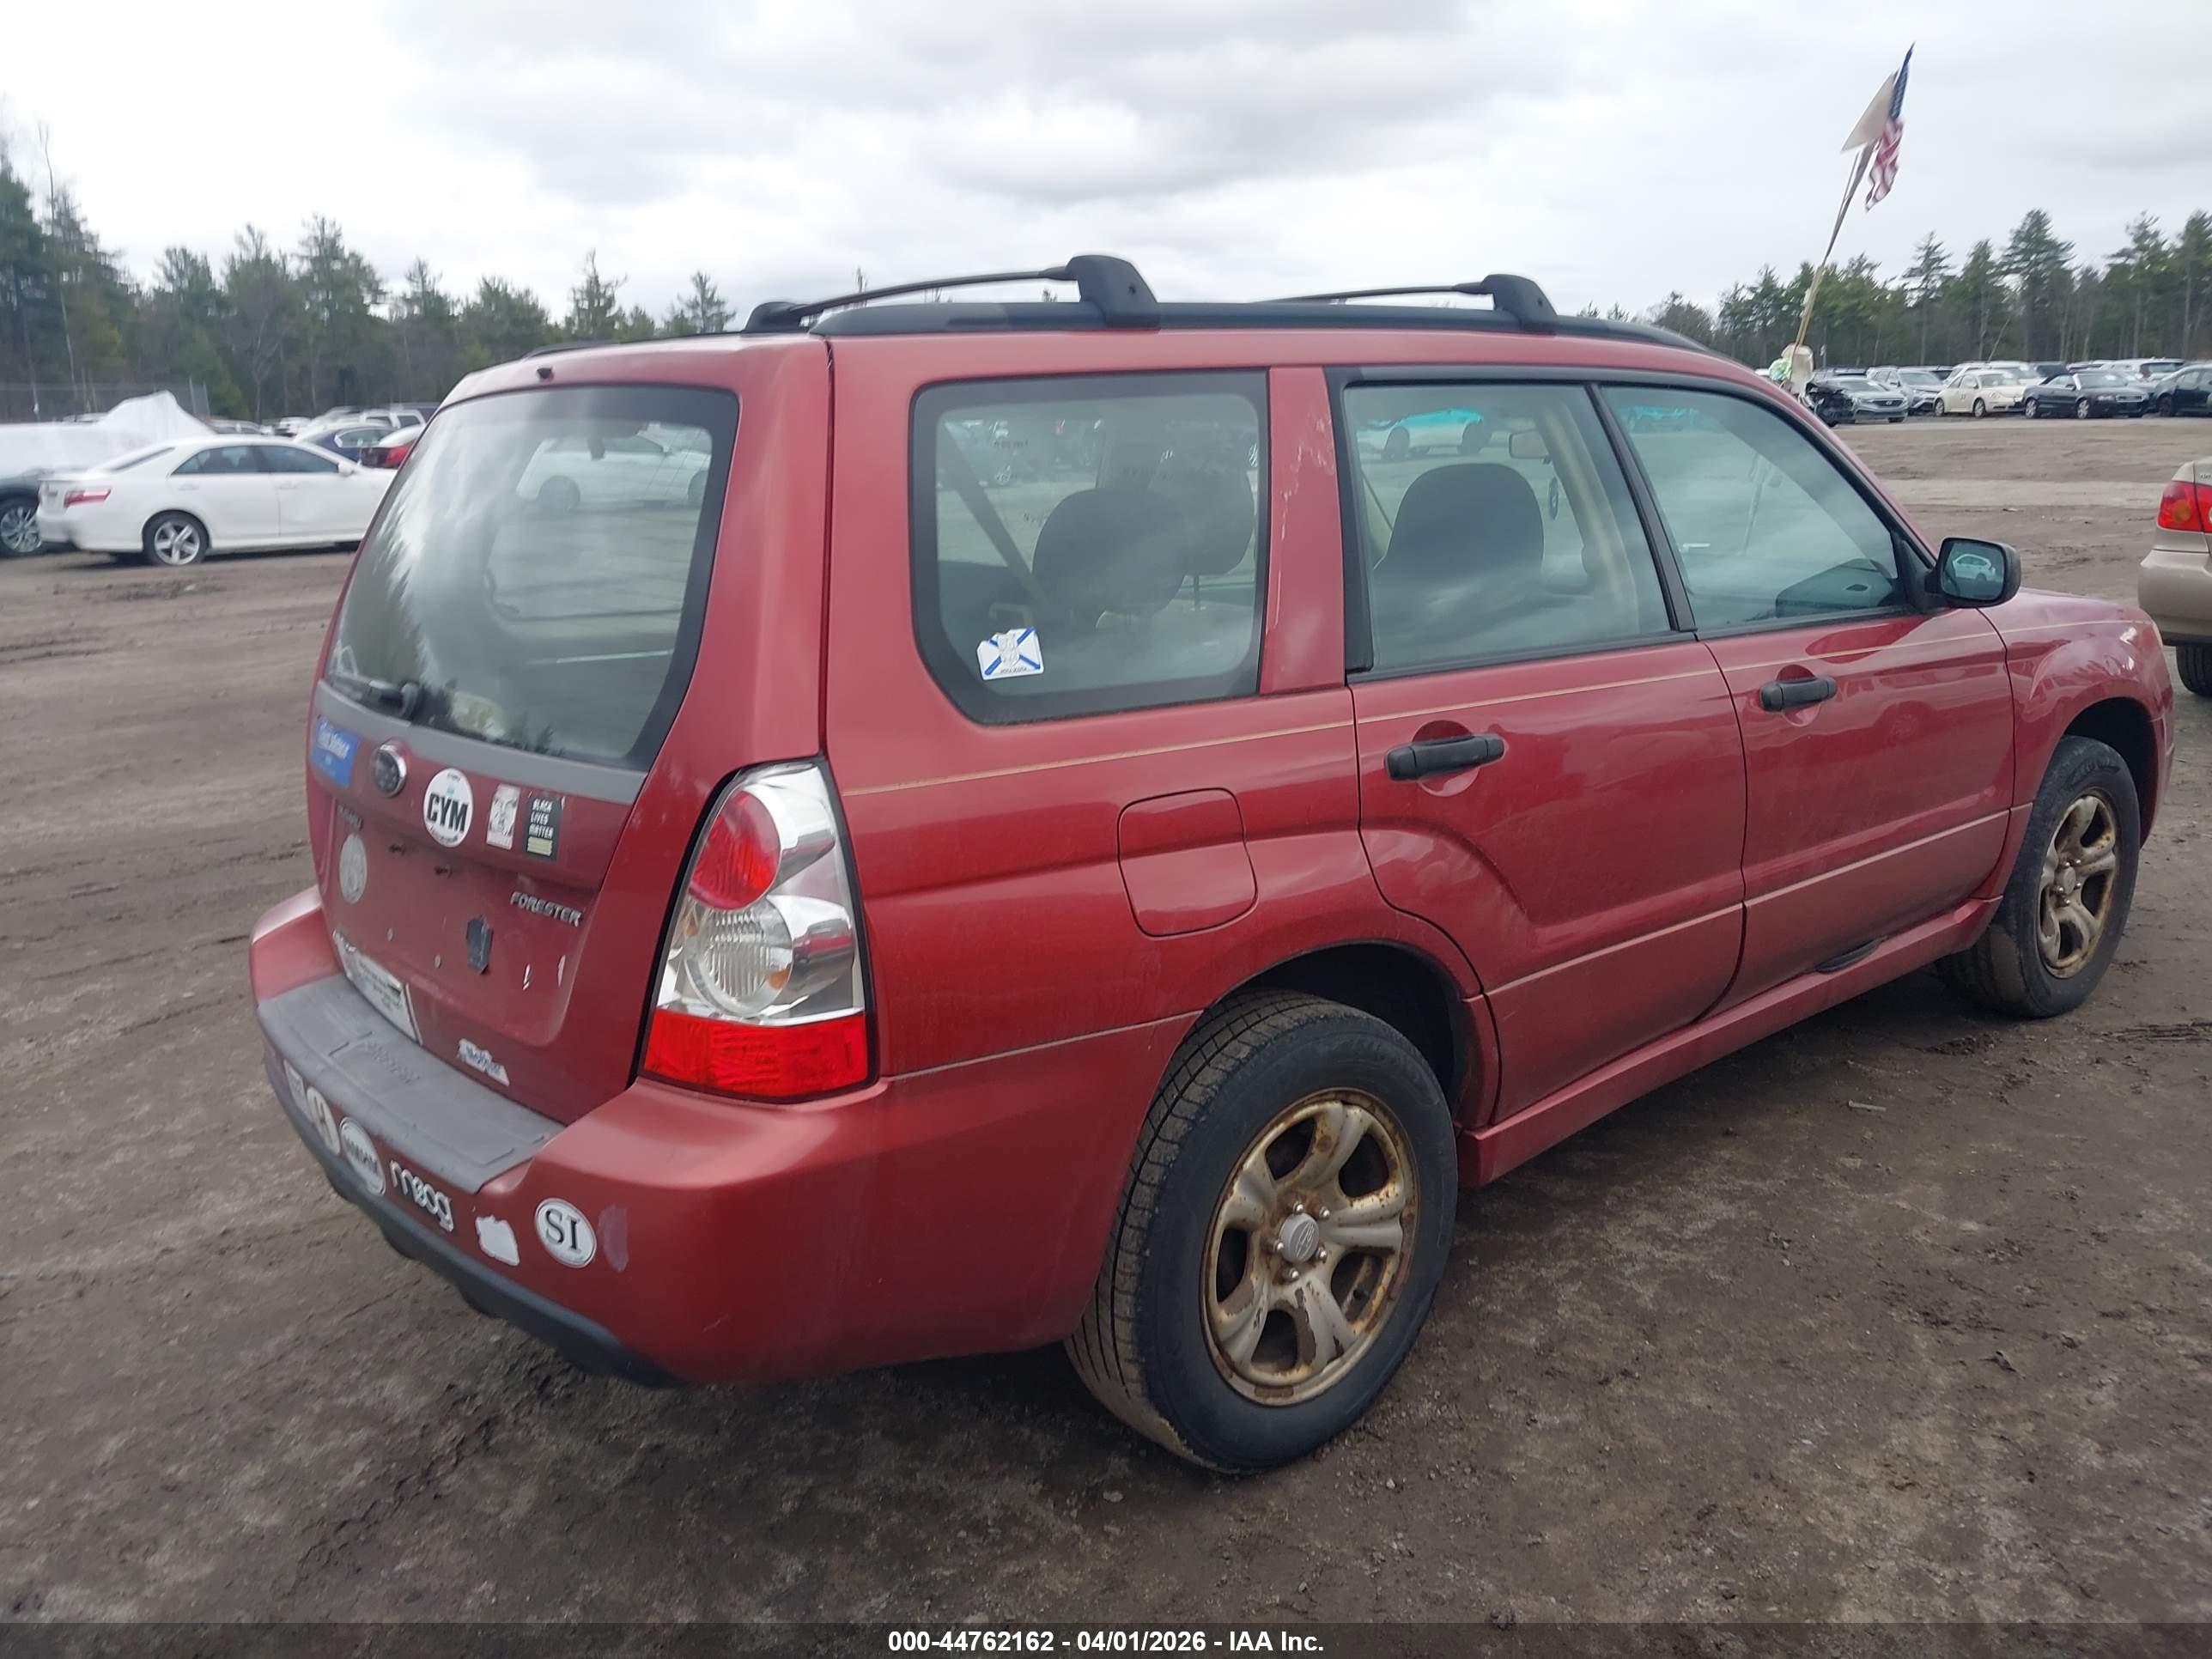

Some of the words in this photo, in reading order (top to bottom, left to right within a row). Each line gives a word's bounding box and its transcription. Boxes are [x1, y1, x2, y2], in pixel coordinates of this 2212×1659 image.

[532, 798, 553, 814] BLACK
[530, 810, 550, 826] LIVES
[528, 823, 554, 839] MATTER
[510, 891, 582, 927] FORESTER
[546, 1208, 581, 1254] SI
